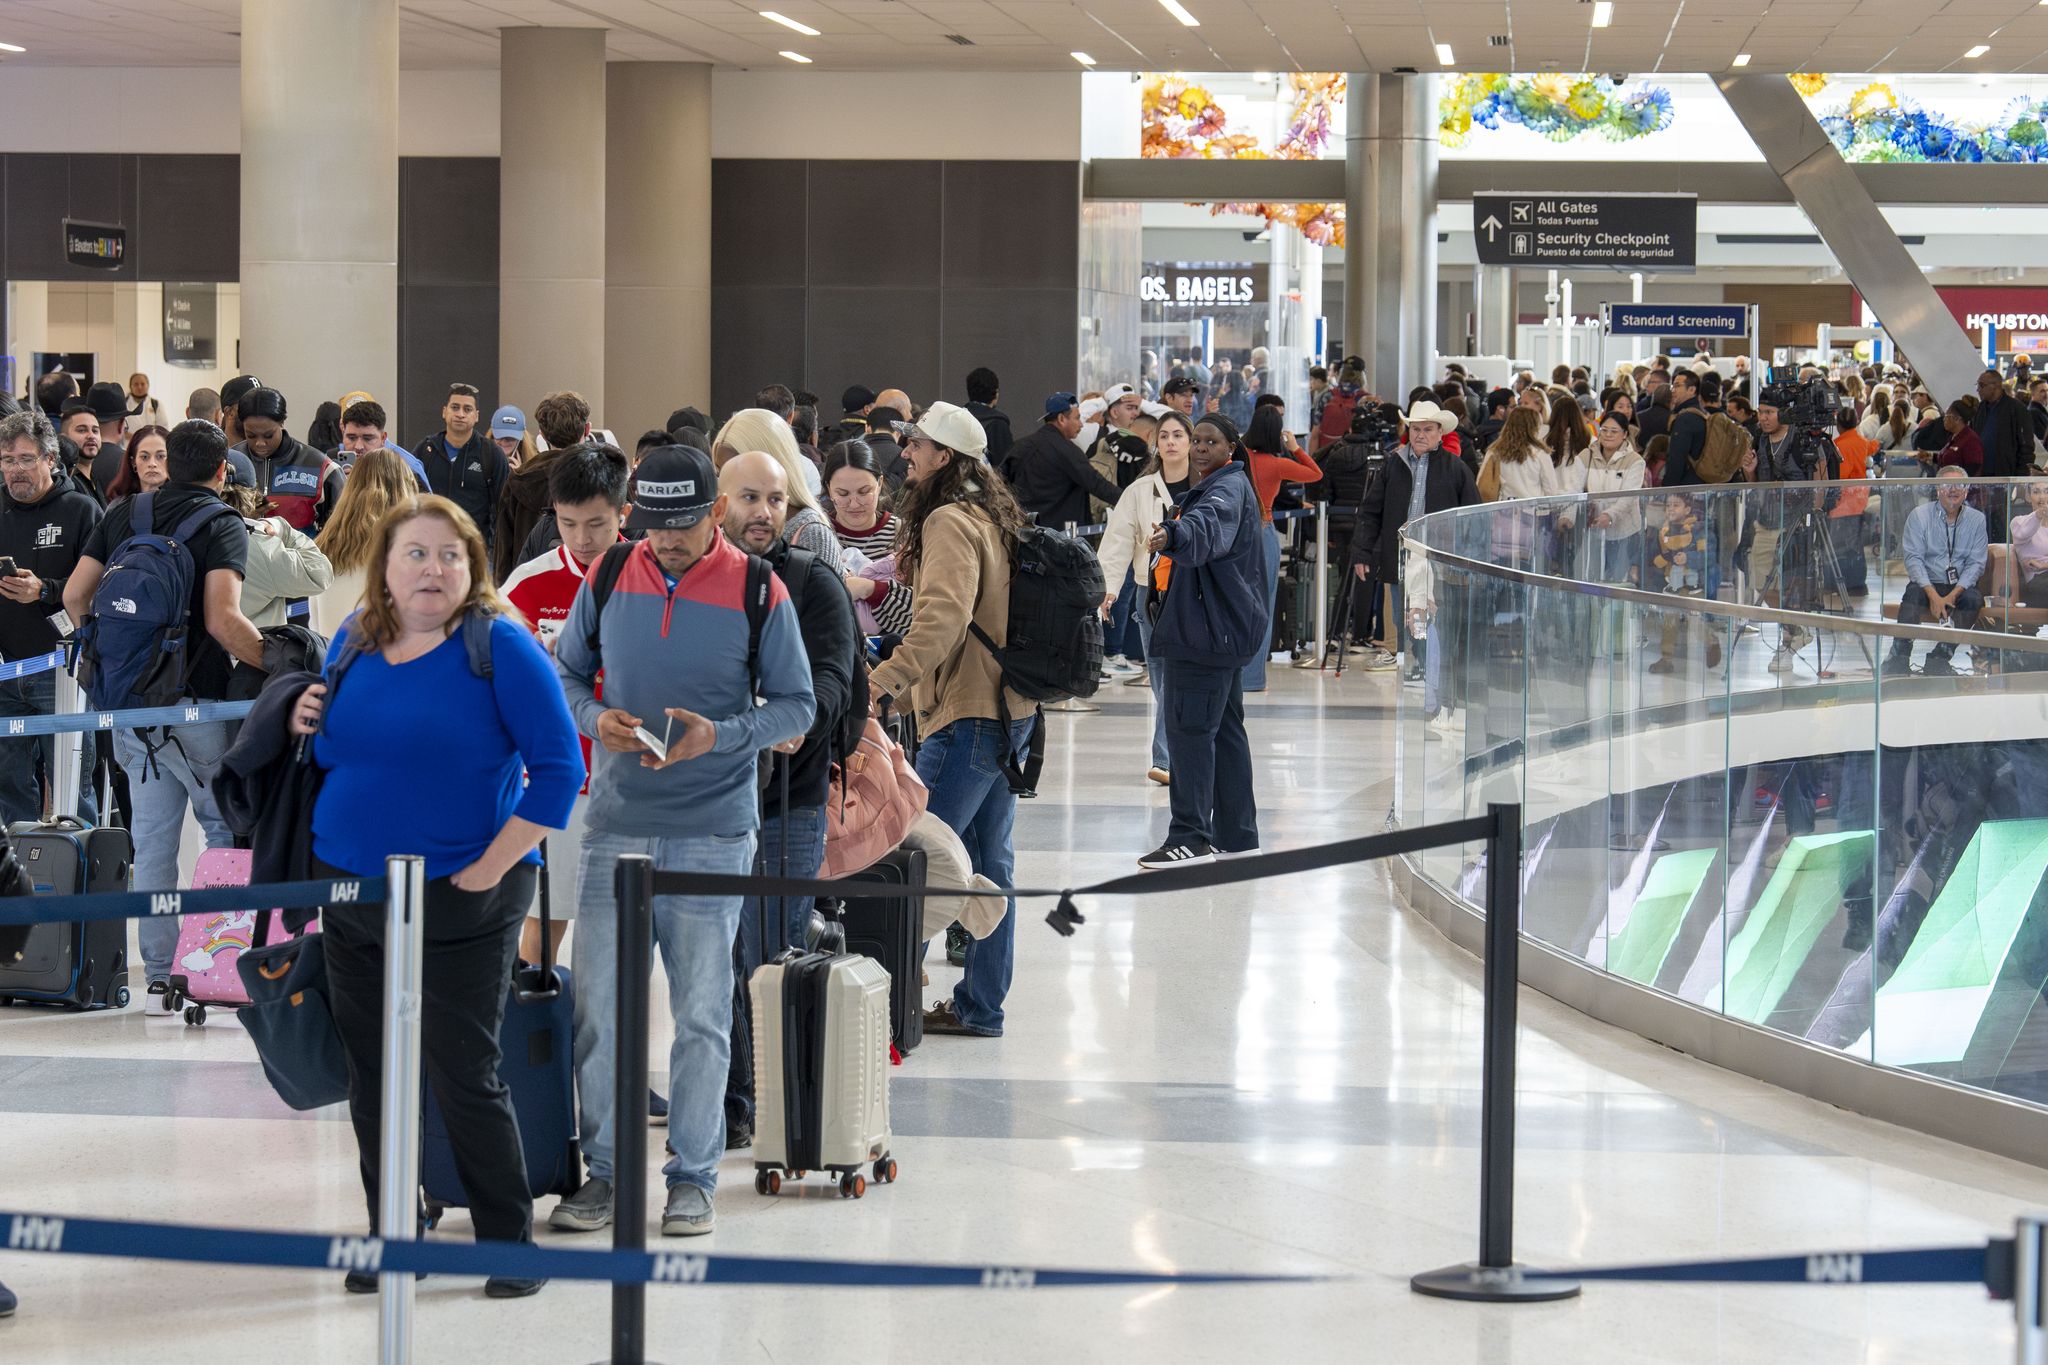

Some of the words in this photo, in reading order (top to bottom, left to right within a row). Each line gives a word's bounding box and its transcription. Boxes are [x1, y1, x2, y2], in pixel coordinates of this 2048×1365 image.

[1537, 201, 1556, 213] All
[1560, 201, 1598, 213] Gates
[1537, 217, 1563, 225] Todas
[1565, 217, 1599, 226] Puertas
[1537, 233, 1591, 247] Security
[1595, 233, 1670, 247] Checkpoint
[1537, 248, 1567, 257] Puesto
[1569, 248, 1581, 257] de
[1582, 248, 1615, 257] control
[1617, 248, 1628, 257] de
[1630, 248, 1674, 258] seguridad
[1176, 276, 1254, 301] BAGELS
[1622, 314, 1674, 327] Standard
[1678, 315, 1736, 330] Screening
[273, 470, 318, 489] CLLSN
[647, 484, 691, 495] ARIAT
[99, 713, 114, 728] IAH
[185, 707, 199, 721] IAH
[9, 719, 25, 734] IAH
[330, 881, 360, 903] IAH
[150, 893, 182, 914] IAH
[1806, 1253, 1863, 1283] IAH
